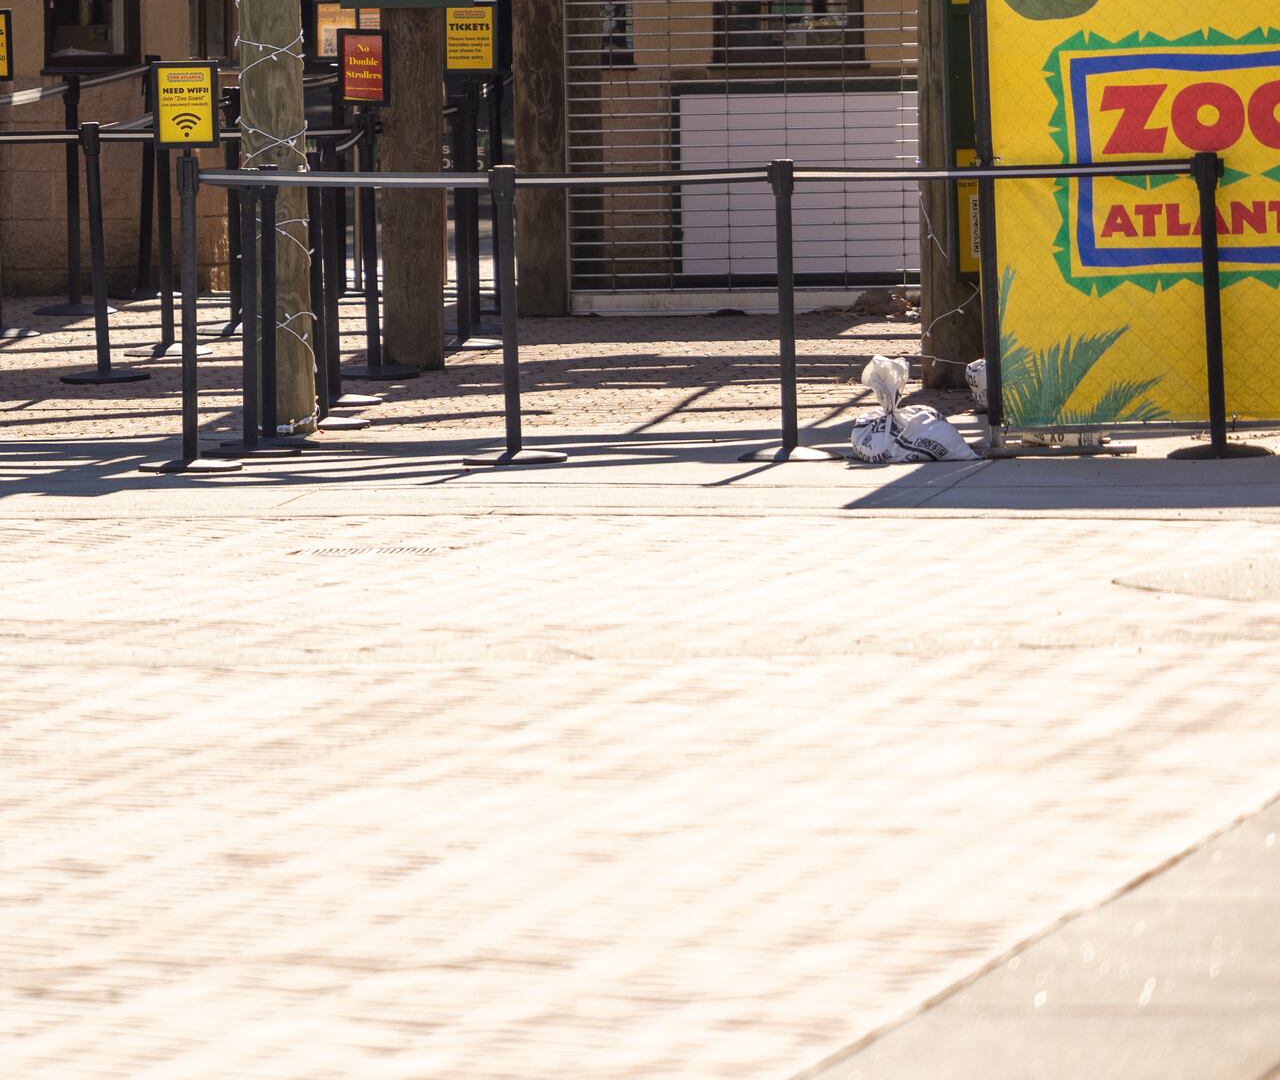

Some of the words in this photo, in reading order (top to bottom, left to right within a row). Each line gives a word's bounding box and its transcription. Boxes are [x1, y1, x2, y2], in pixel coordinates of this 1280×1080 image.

[449, 23, 490, 31] TICKETS
[357, 44, 370, 53] No
[349, 57, 379, 66] Double
[346, 70, 382, 79] Strollers
